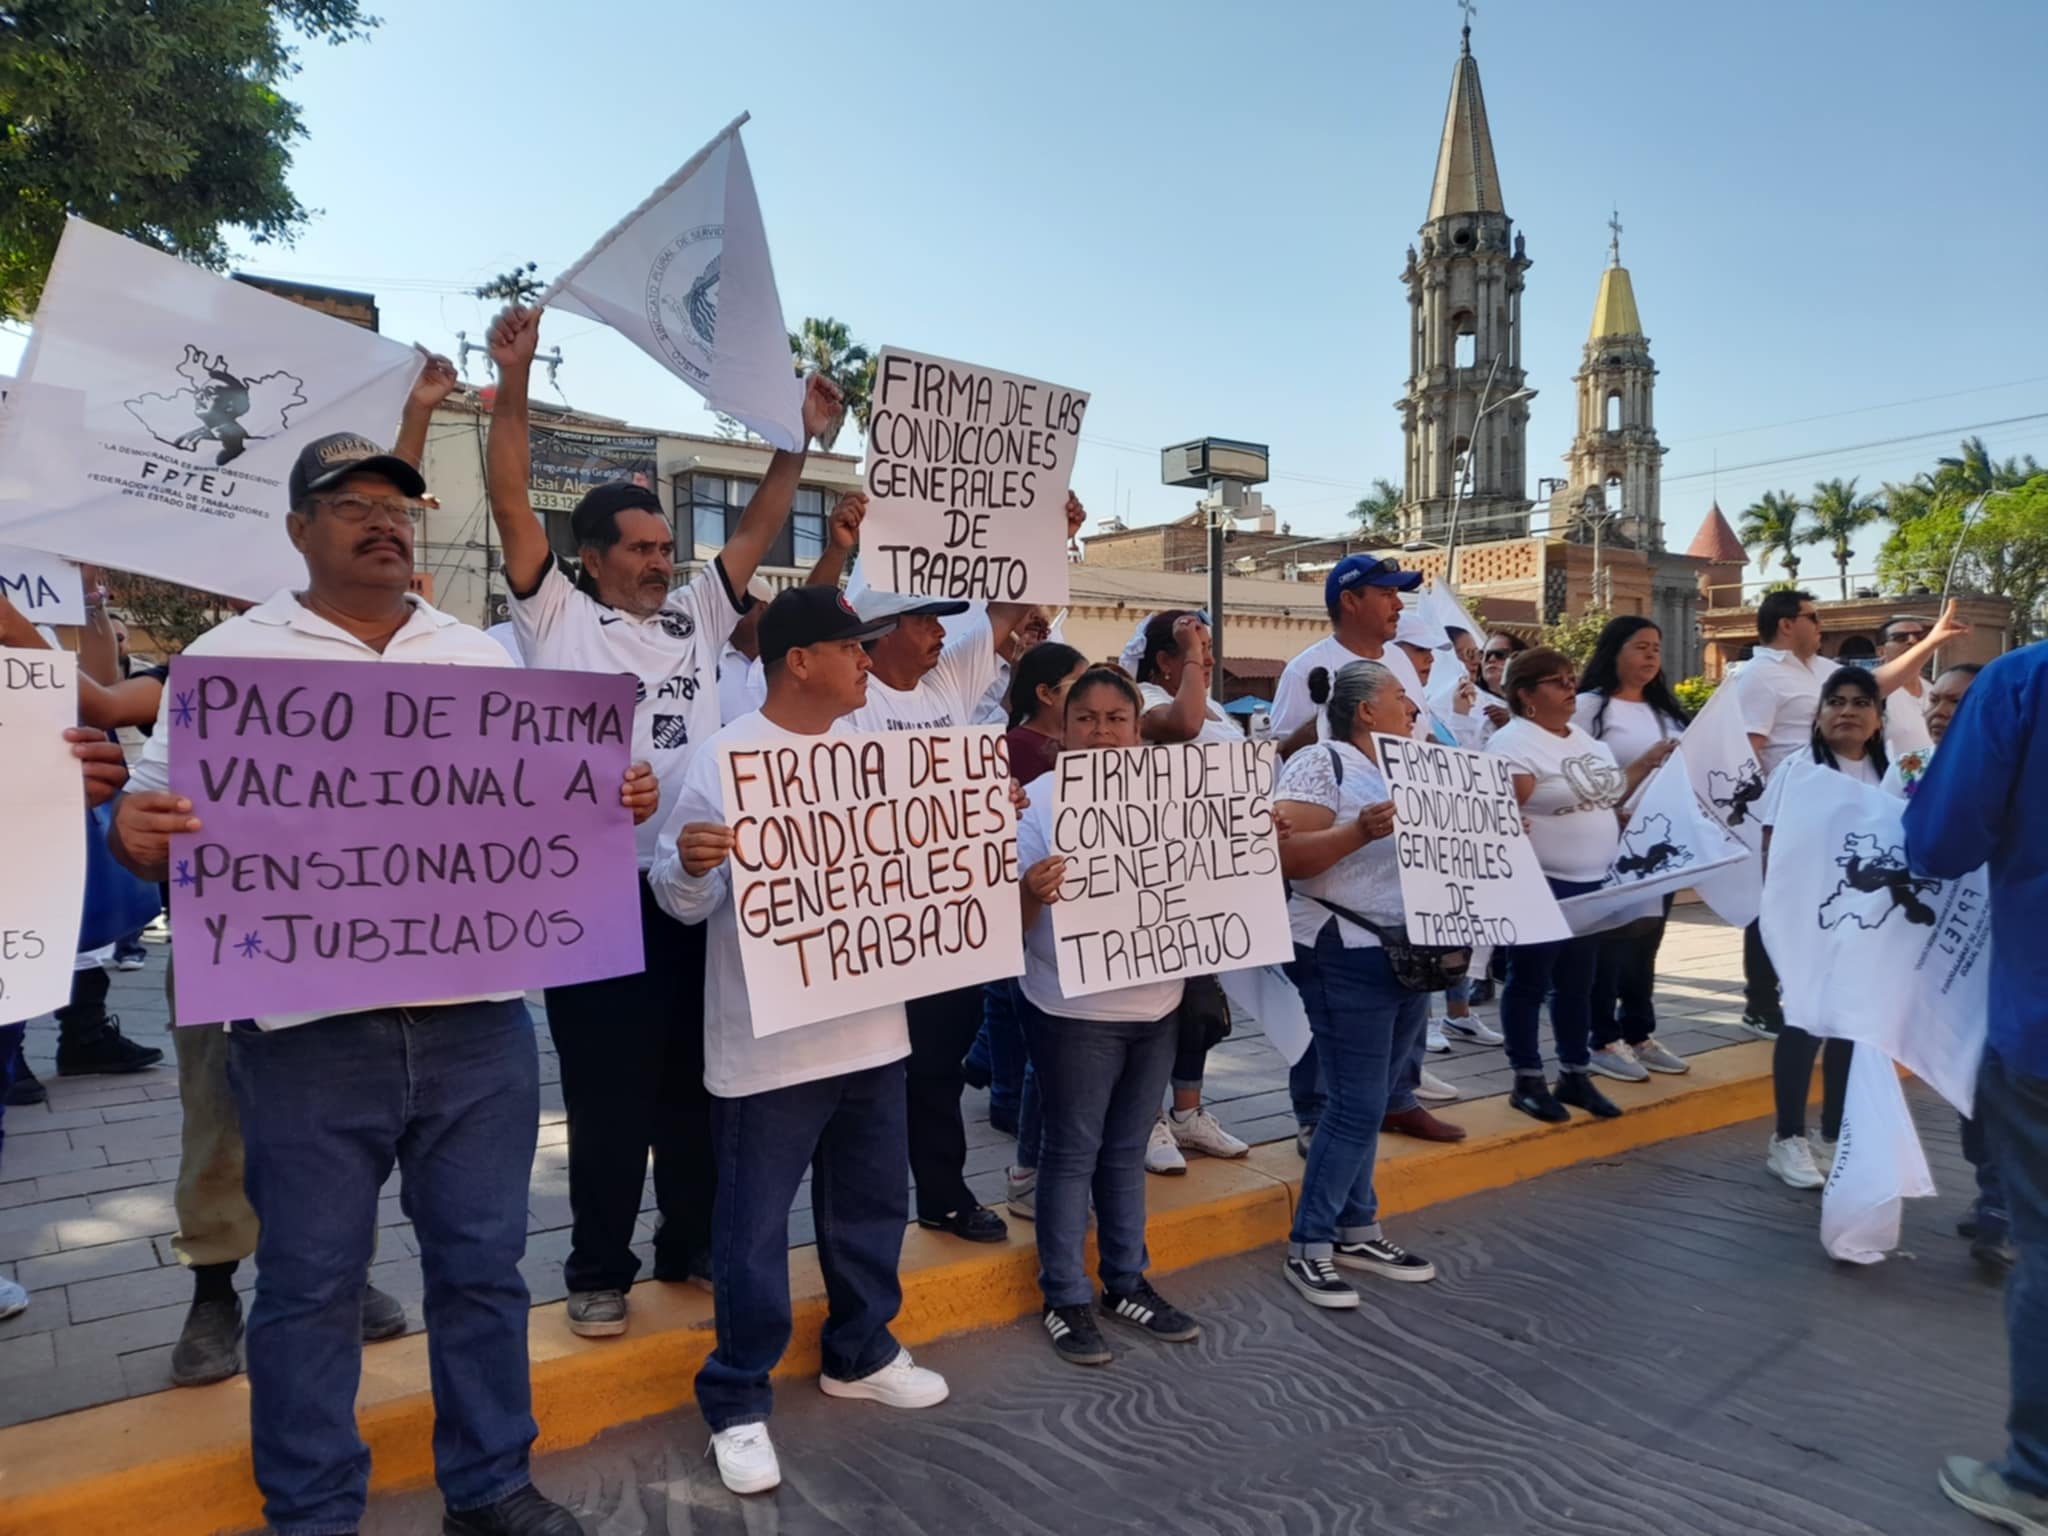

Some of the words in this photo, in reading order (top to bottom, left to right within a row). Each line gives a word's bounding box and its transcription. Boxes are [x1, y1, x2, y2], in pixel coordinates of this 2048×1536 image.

[882, 355, 993, 424] FIRMA
[999, 380, 1037, 427] DE
[1046, 390, 1086, 437] LAS
[871, 409, 1057, 471] CONDICIONES
[185, 493, 198, 503] DE
[533, 493, 558, 508] 333
[869, 458, 1036, 509] GENERALES
[944, 509, 991, 549] DE
[878, 545, 1027, 601] TRABAJO
[5, 657, 65, 690] DEL
[198, 676, 354, 741] PAGO
[384, 691, 456, 739] DE
[479, 691, 624, 746] PRIMA
[199, 756, 536, 808] VACACIONAL
[564, 760, 597, 804] A
[728, 740, 887, 811] FIRMA
[909, 735, 952, 789] DE
[963, 733, 1010, 780] LAS
[1061, 746, 1172, 802] FIRMA
[1183, 743, 1225, 799] DE
[1229, 740, 1273, 796] LAS
[1378, 737, 1453, 787] FIRMA
[1453, 752, 1489, 795] DE
[731, 785, 1005, 872] CONDICIONES
[1055, 796, 1273, 853] CONDICIONES
[1391, 784, 1520, 837] CONDICIONES
[194, 834, 579, 898] PENSIONADOS
[1056, 838, 1278, 902] GENERALES
[1398, 831, 1513, 880] GENERALES
[740, 845, 974, 938] GENERALES
[983, 838, 1019, 888] DE
[1136, 884, 1191, 928] DE
[1445, 882, 1479, 919] DE
[2, 929, 45, 961] ES
[204, 913, 227, 965] Y
[262, 909, 584, 963] JUBILADOS
[773, 894, 988, 988] TRABAJO
[1061, 912, 1250, 984] TRABAJO
[1415, 911, 1517, 946] TRABAJO
